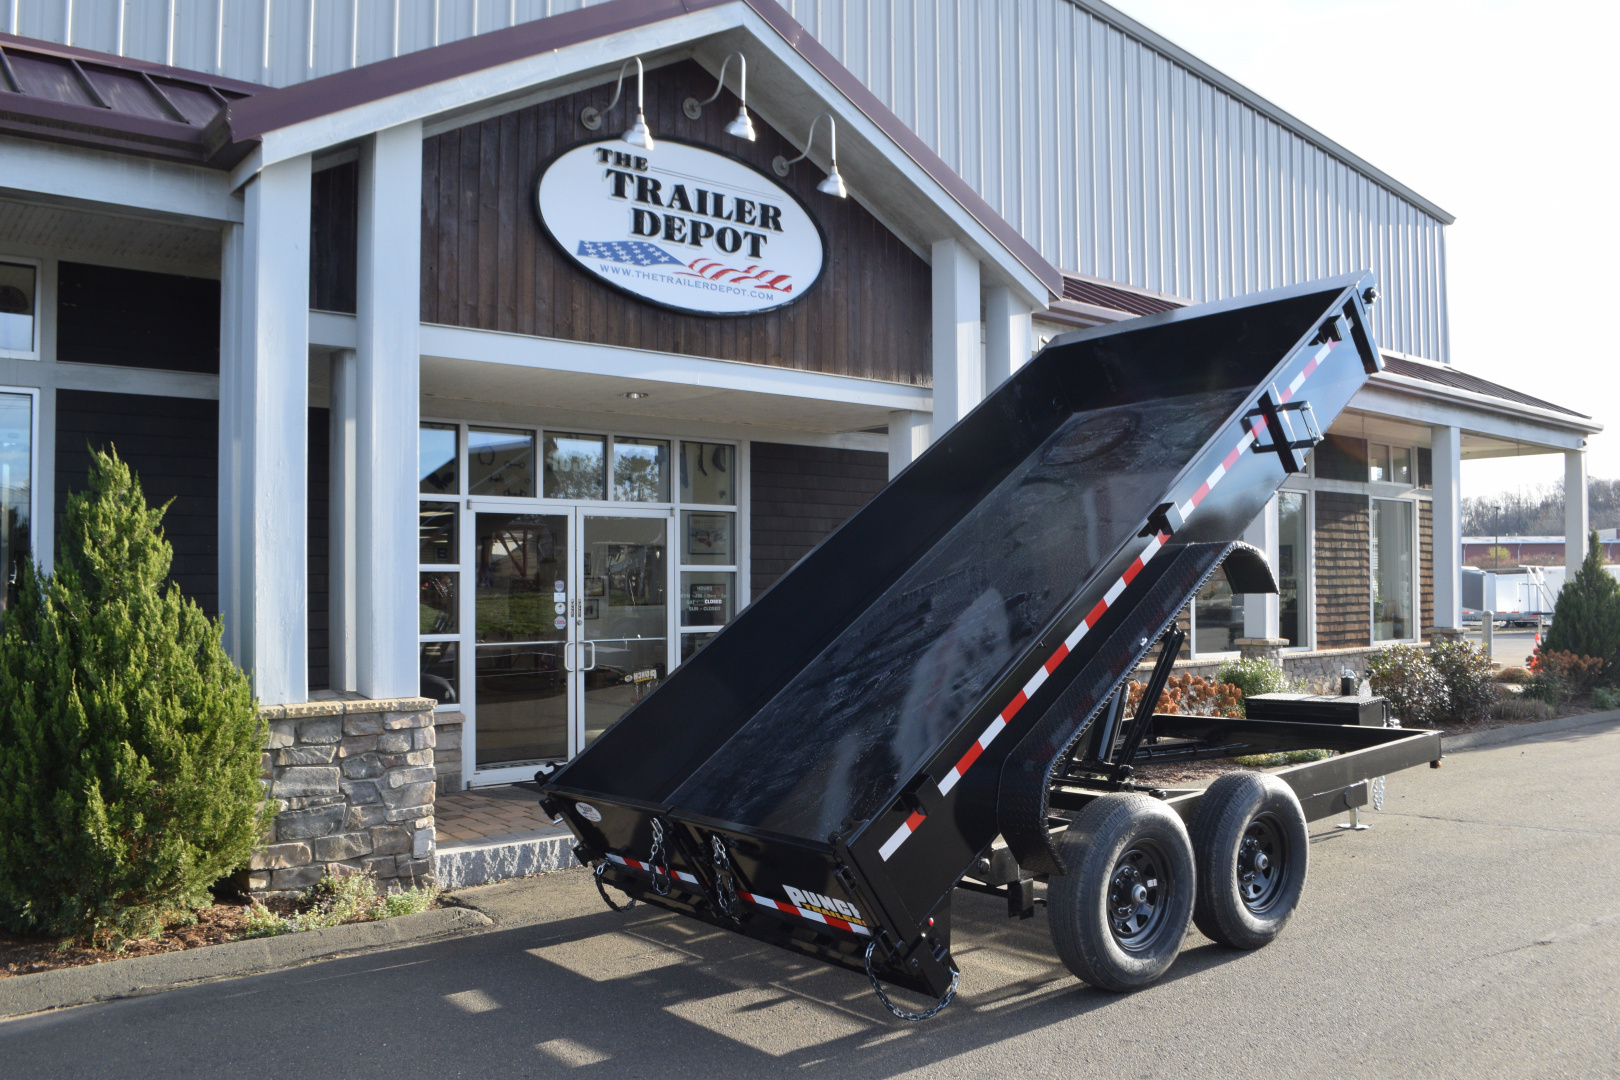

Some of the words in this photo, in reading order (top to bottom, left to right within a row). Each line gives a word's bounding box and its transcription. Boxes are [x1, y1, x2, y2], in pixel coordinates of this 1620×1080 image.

[595, 147, 648, 171] THE
[605, 168, 784, 232] TRAILER
[630, 207, 768, 259] DEPOT
[599, 264, 774, 301] WWW.THETRAILERDEPOT.COM
